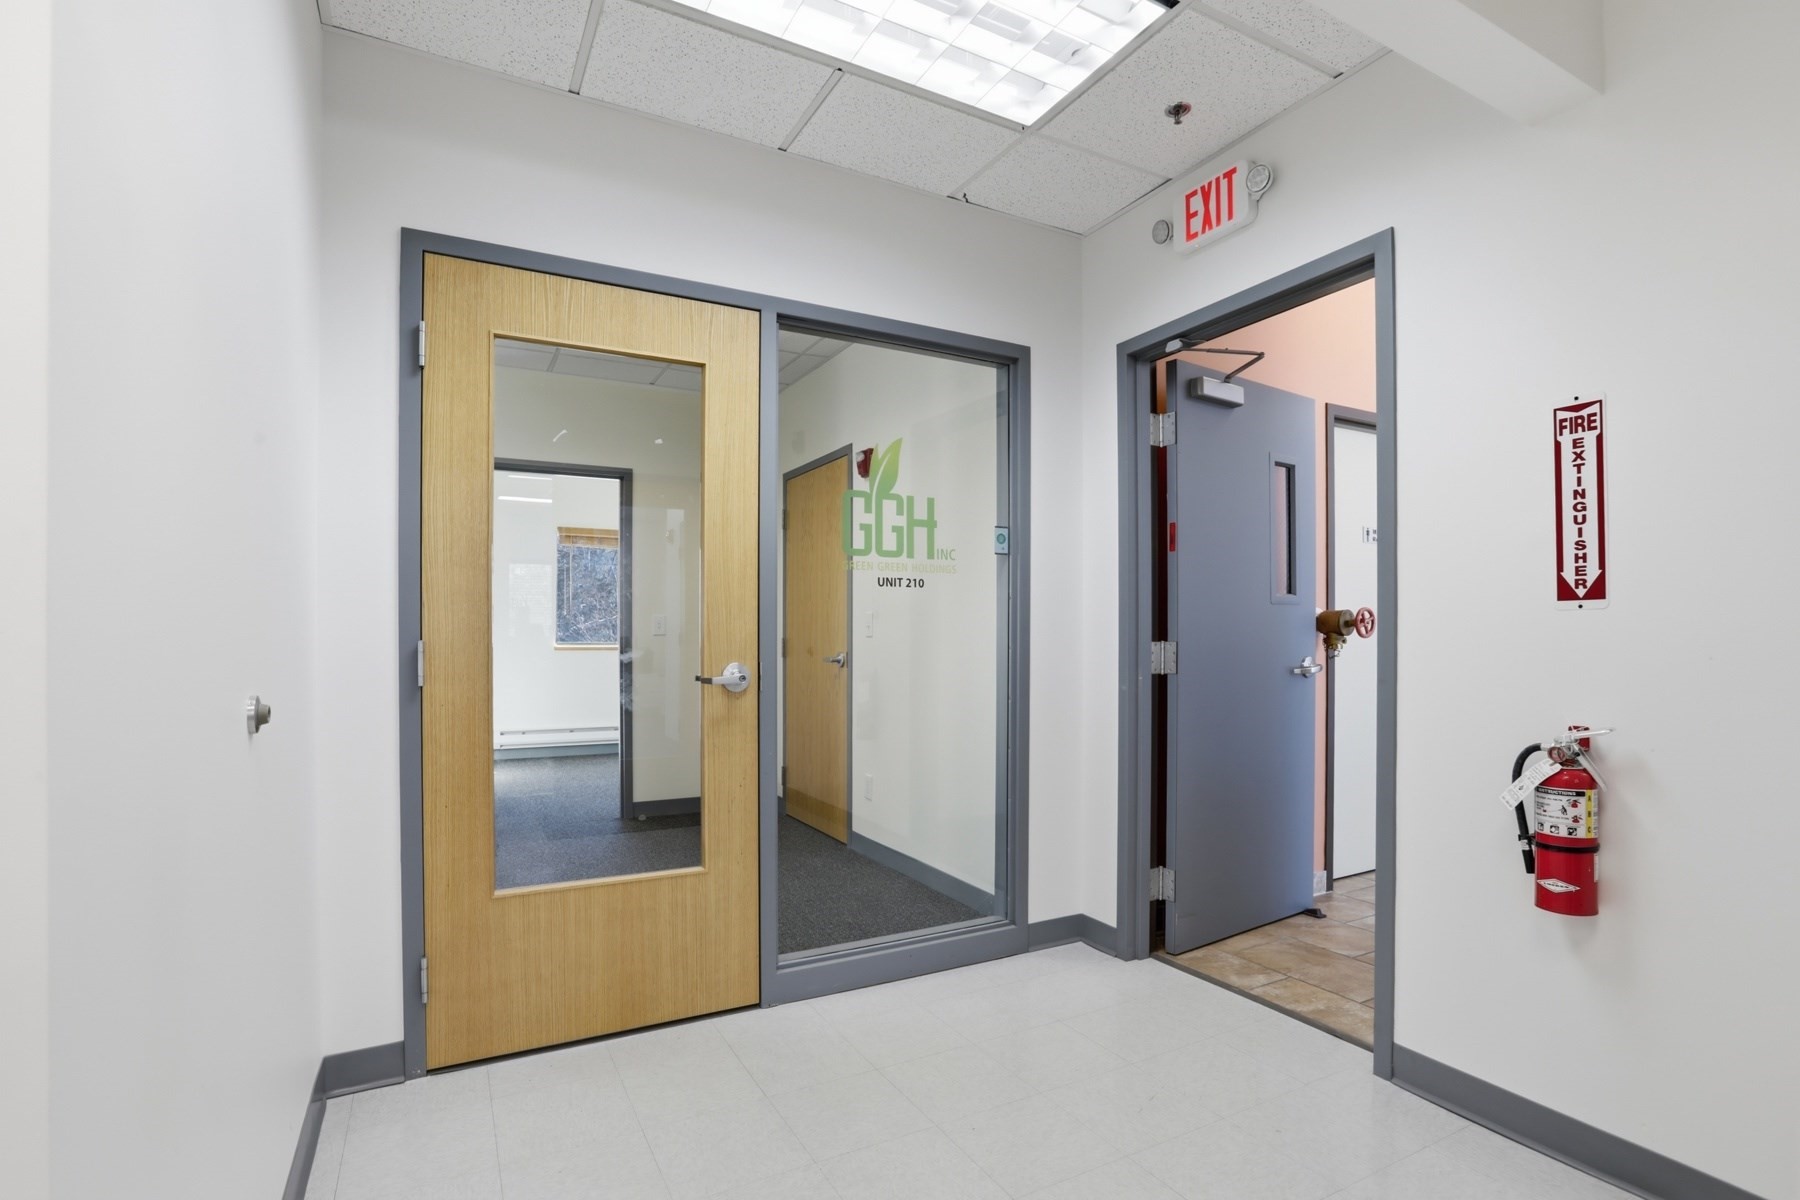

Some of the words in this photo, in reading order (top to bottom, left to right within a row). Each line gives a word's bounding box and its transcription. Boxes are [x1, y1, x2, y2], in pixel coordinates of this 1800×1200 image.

[1185, 166, 1238, 242] EXIT
[1558, 411, 1598, 437] FIRE
[842, 489, 938, 560] GGH
[936, 548, 957, 561] INC
[1571, 437, 1588, 590] EXTINGUISHER
[877, 562, 908, 573] GREEN
[911, 563, 957, 575] HOLDINGS
[877, 576, 904, 588] UNIT
[905, 578, 925, 588] 210
